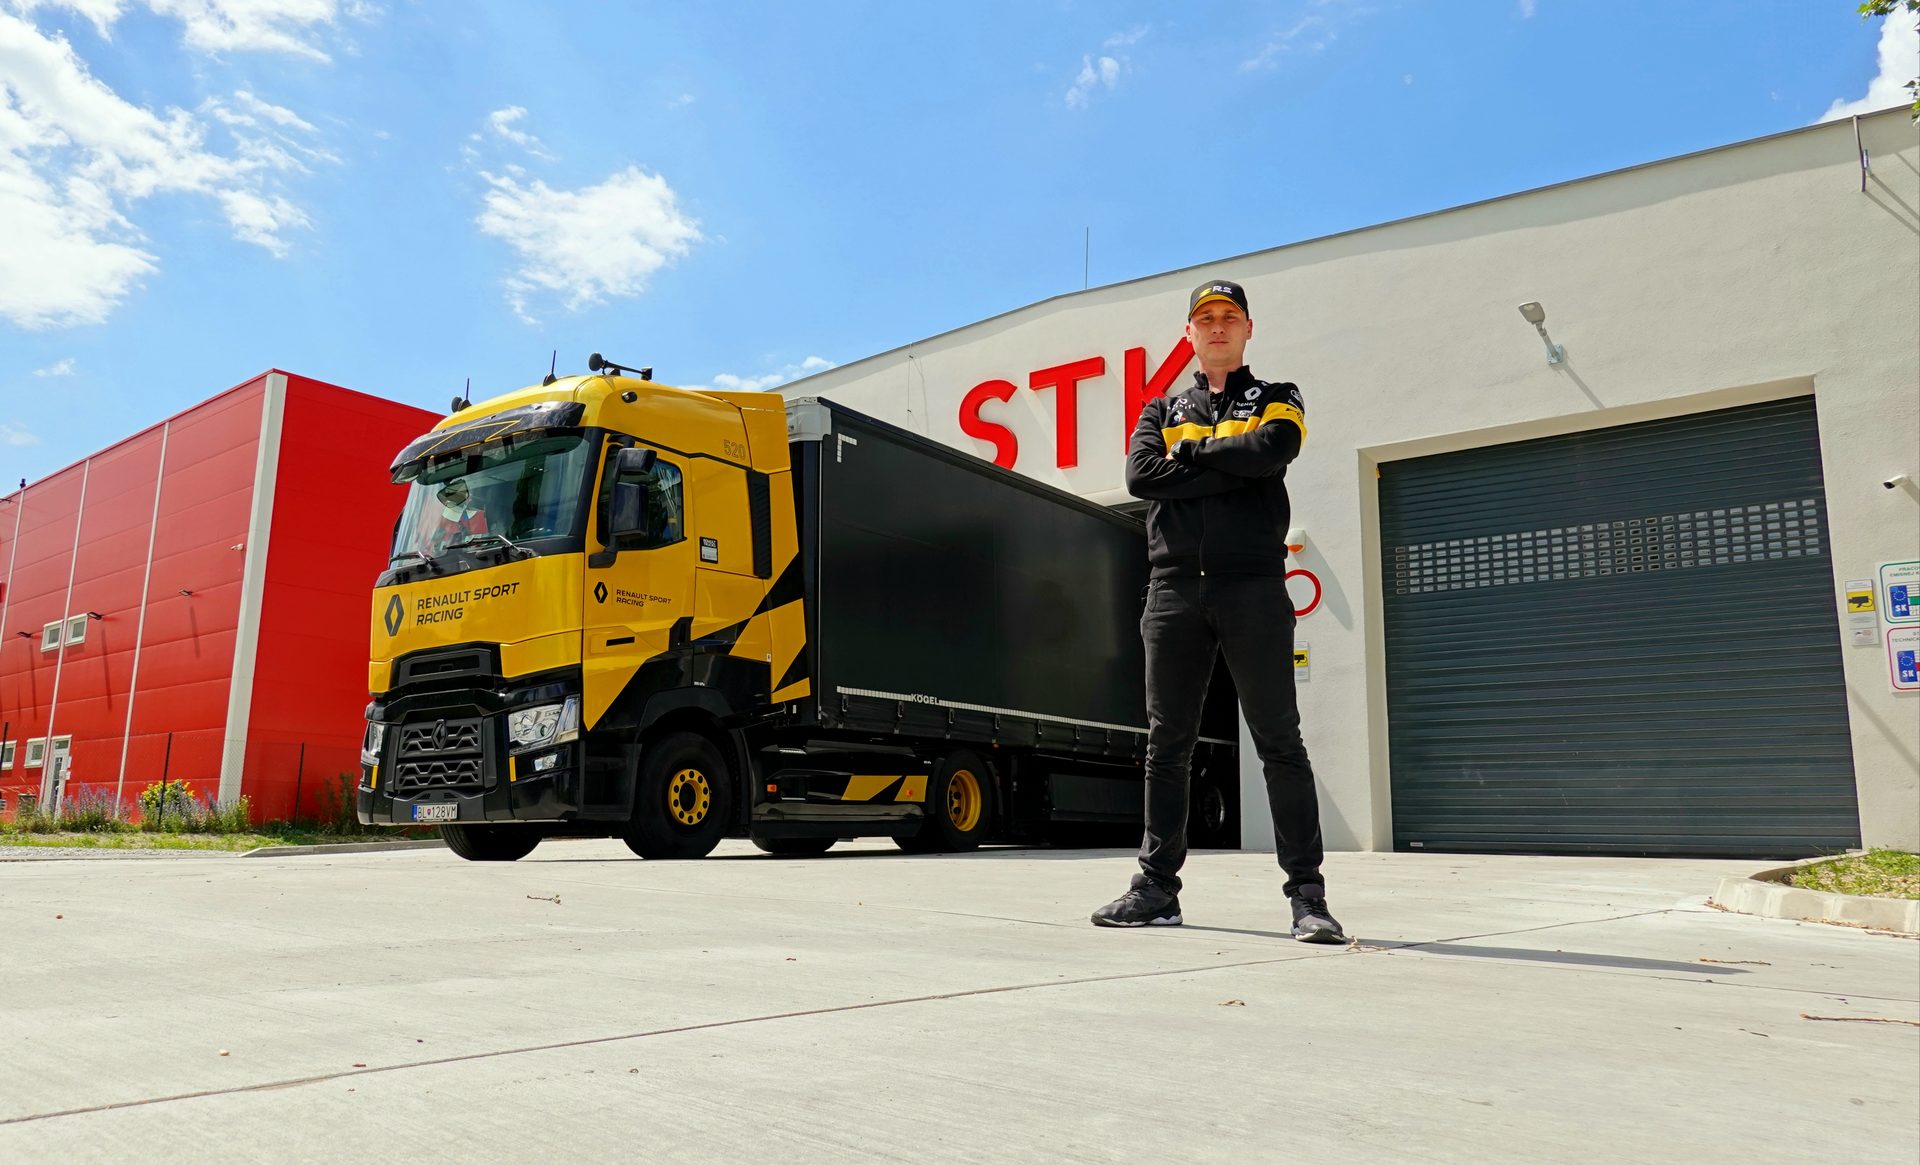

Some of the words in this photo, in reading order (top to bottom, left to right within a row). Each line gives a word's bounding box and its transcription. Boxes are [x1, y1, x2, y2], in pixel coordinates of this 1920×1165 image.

[959, 336, 1196, 471] STK
[723, 439, 746, 461] 520
[417, 591, 471, 610] RENAULT
[473, 582, 520, 600] SPORT
[616, 589, 648, 600] RENAULT
[649, 595, 672, 604] SPORT
[616, 596, 645, 607] RACING
[1895, 604, 1908, 612] SK
[416, 607, 463, 626] RACING
[1902, 669, 1914, 678] SK
[911, 693, 940, 706] KÖGEL
[417, 806, 427, 819] BL
[432, 805, 457, 819] 128VM
